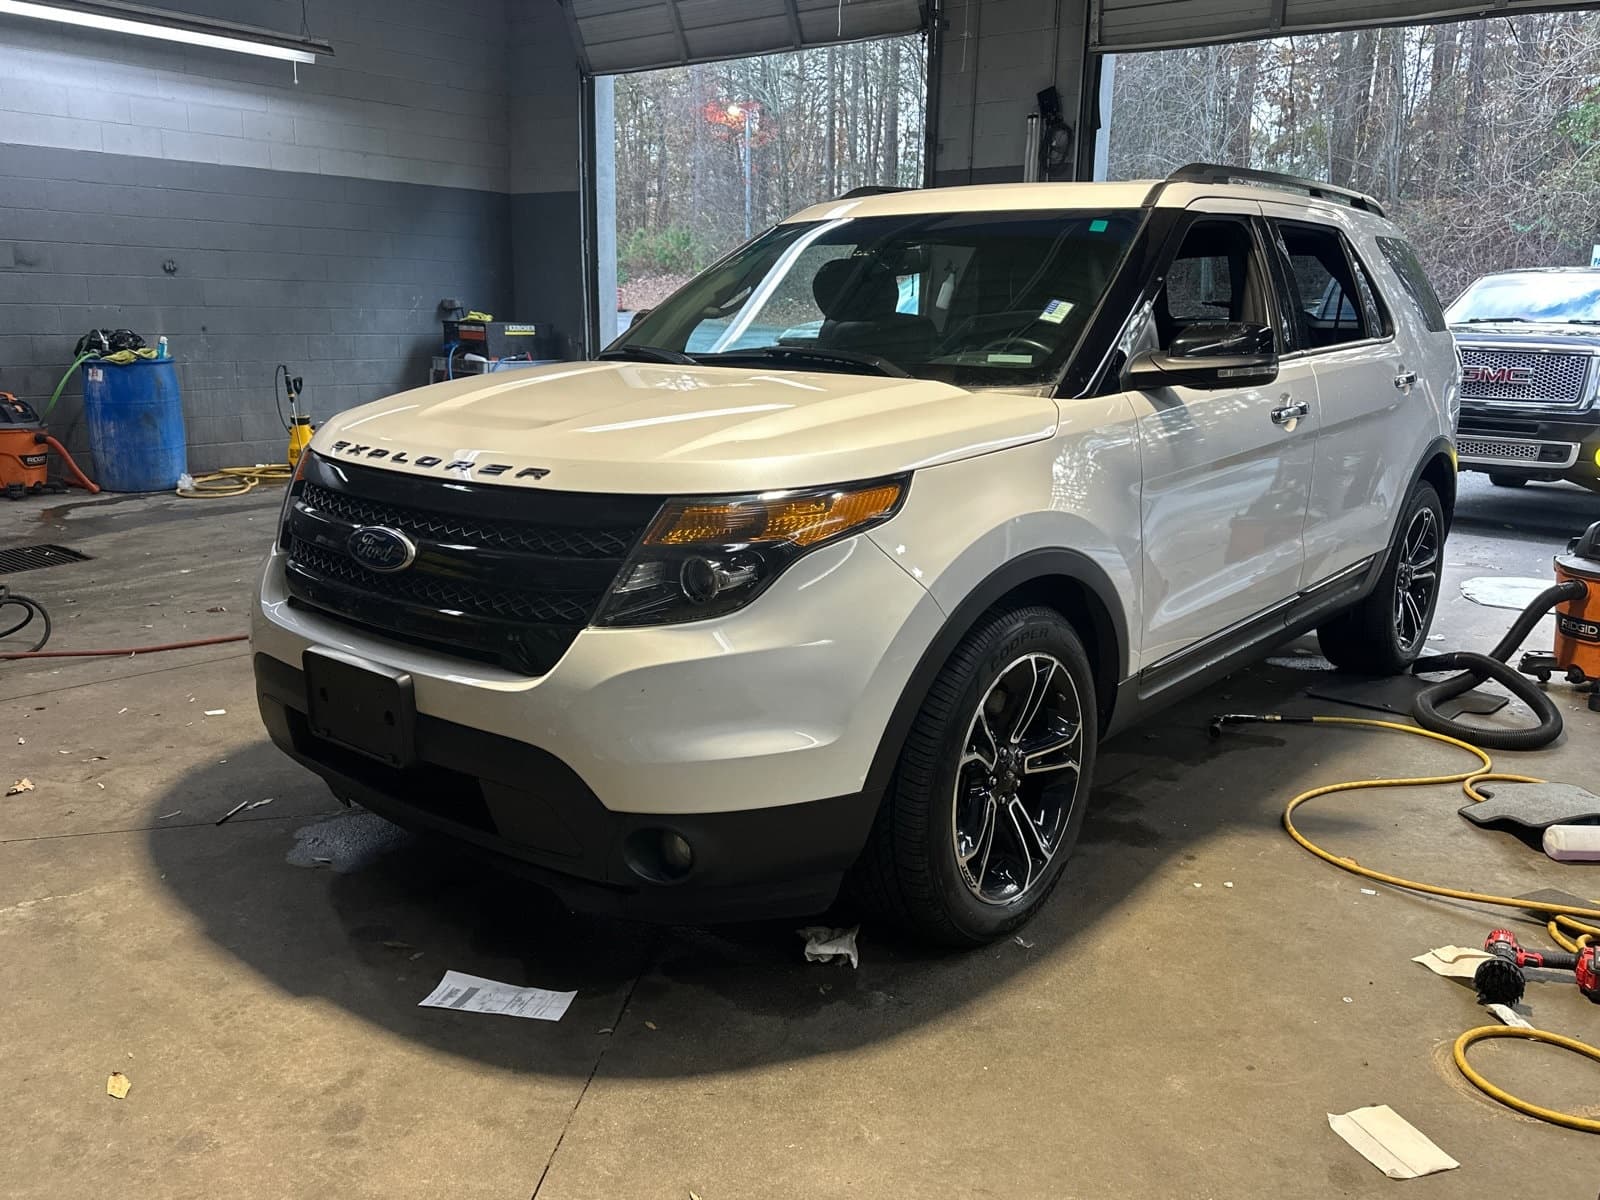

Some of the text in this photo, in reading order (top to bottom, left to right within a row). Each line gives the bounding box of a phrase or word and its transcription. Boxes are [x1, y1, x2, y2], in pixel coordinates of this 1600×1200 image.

[1462, 365, 1533, 384] GMC
[333, 440, 551, 480] EXPLORER
[357, 533, 395, 562] Ford
[1561, 618, 1599, 635] RIDGID
